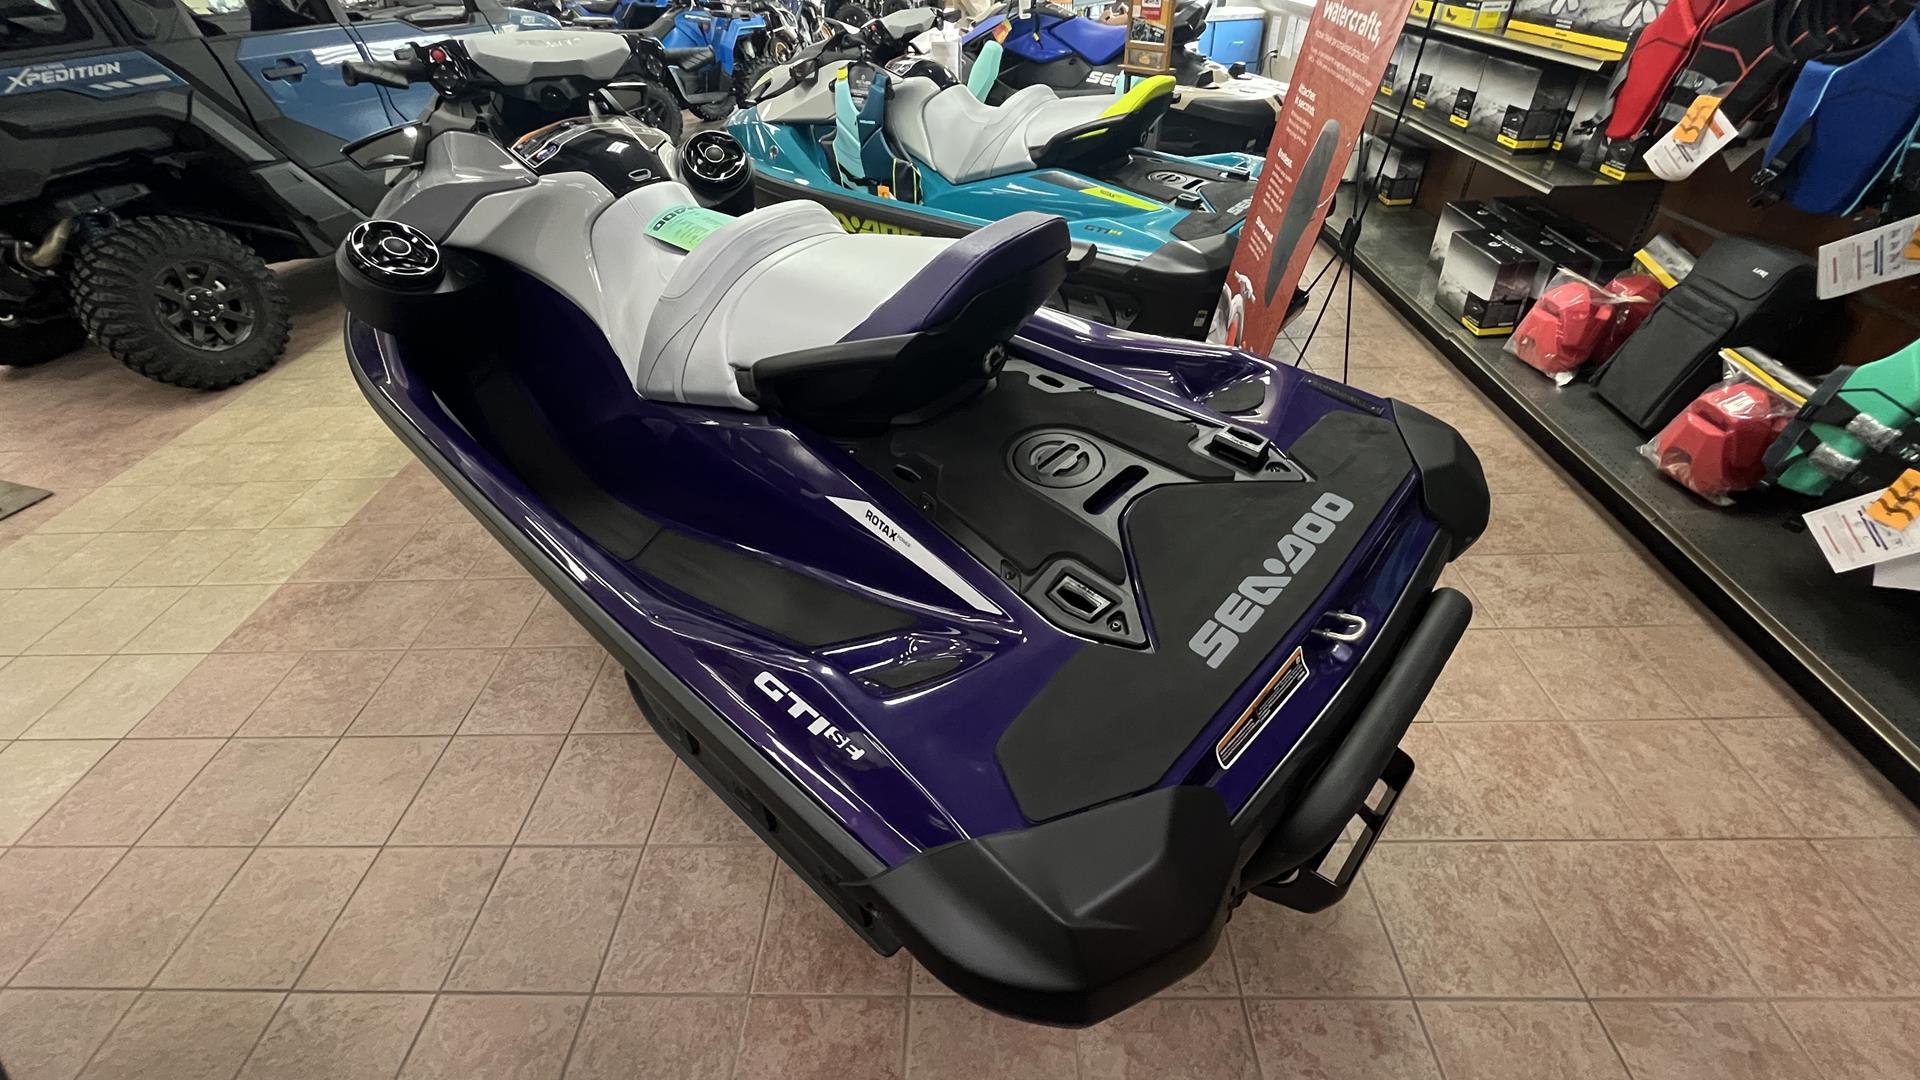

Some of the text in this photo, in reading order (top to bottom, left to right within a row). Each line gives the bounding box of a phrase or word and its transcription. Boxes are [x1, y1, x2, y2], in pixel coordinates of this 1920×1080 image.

[4, 61, 121, 94] XPEDITION
[865, 509, 898, 542] ROTAX
[753, 671, 831, 736] GTI
